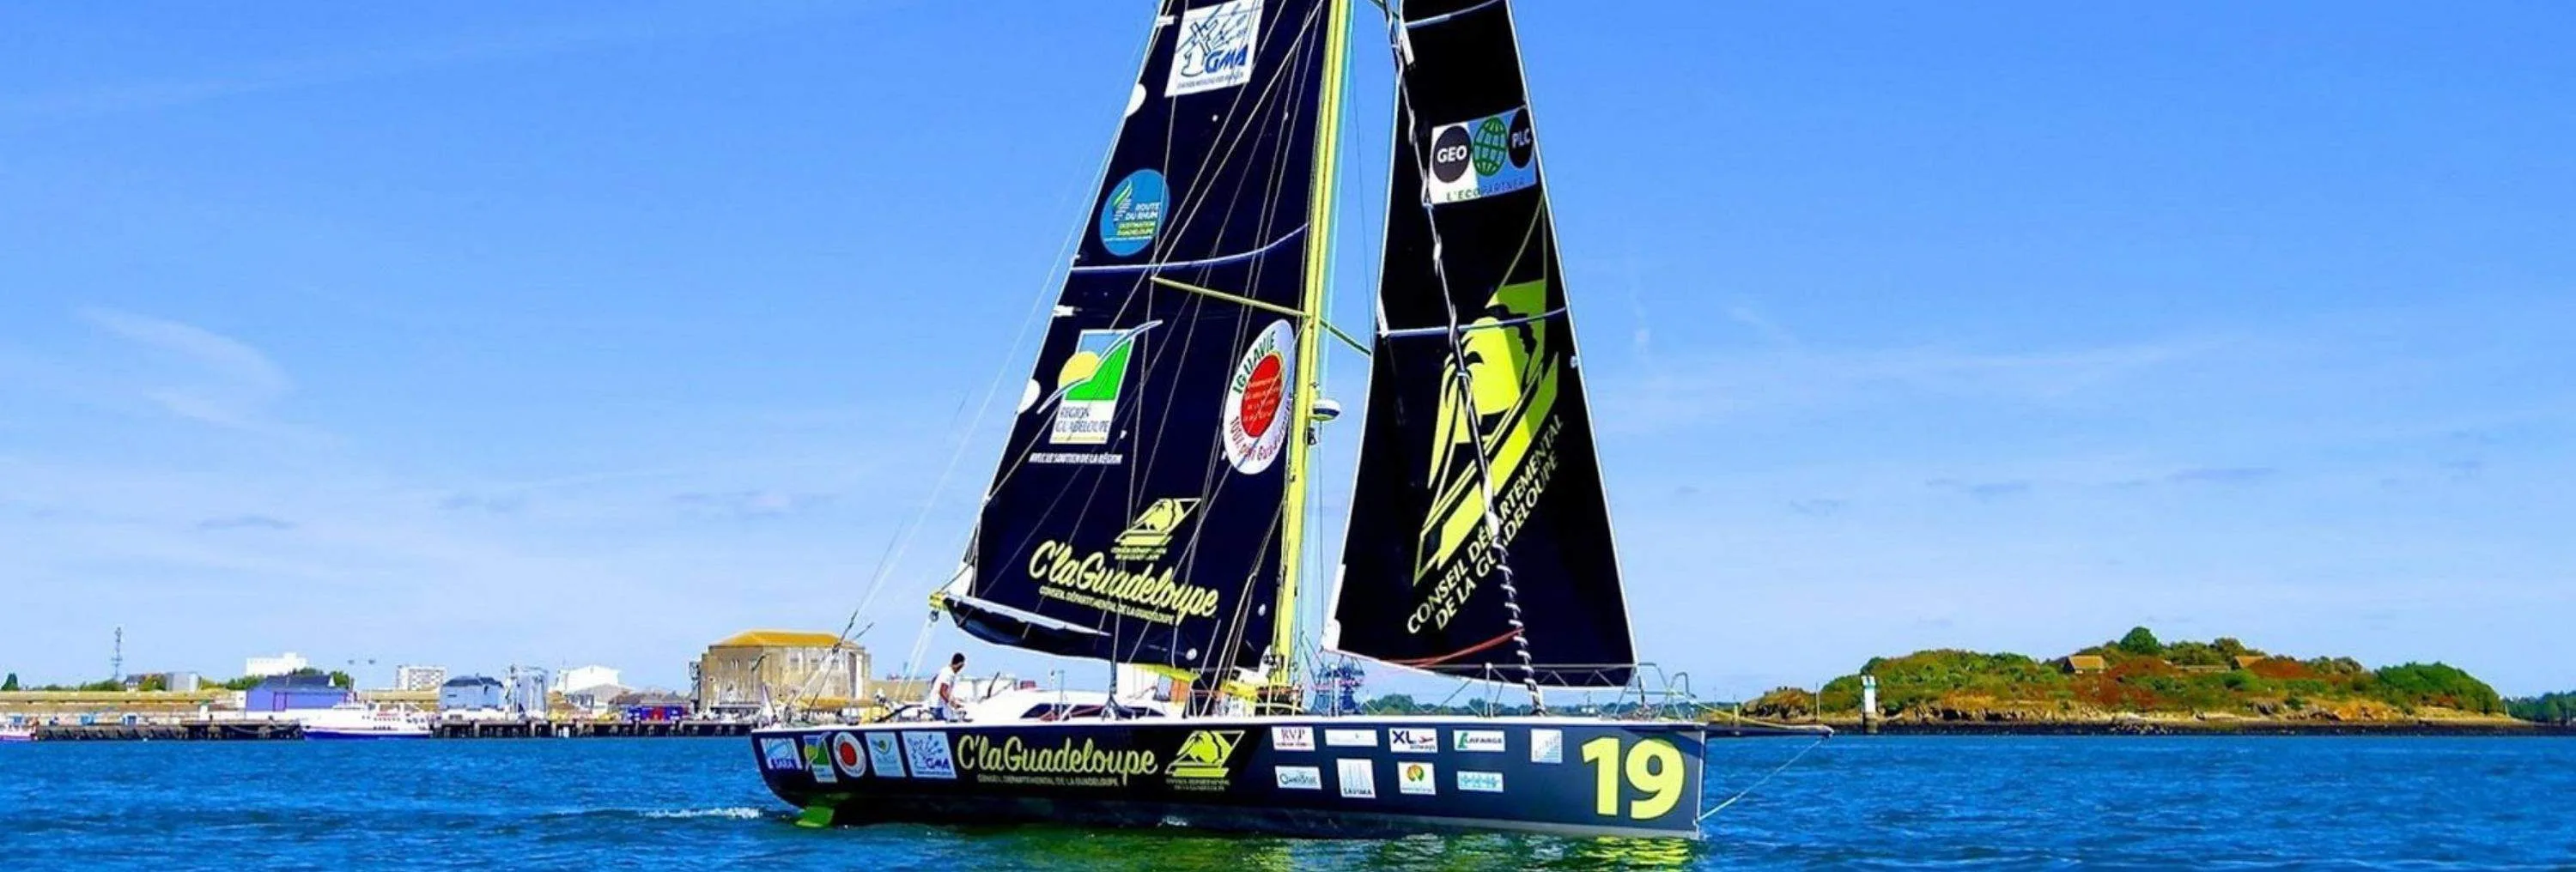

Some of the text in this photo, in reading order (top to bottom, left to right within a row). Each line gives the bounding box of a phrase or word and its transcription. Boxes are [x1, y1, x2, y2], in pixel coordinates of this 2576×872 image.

[1206, 44, 1249, 74] GMA
[1437, 129, 1531, 163] GEO PLC
[1406, 415, 1564, 634] CONSEIL DÉRTEMENTAL
[1435, 597, 1457, 631] DE
[1456, 577, 1477, 604] LA
[1393, 730, 1417, 744] XL
[926, 758, 951, 770] GMA
[1582, 736, 1685, 820] 19
